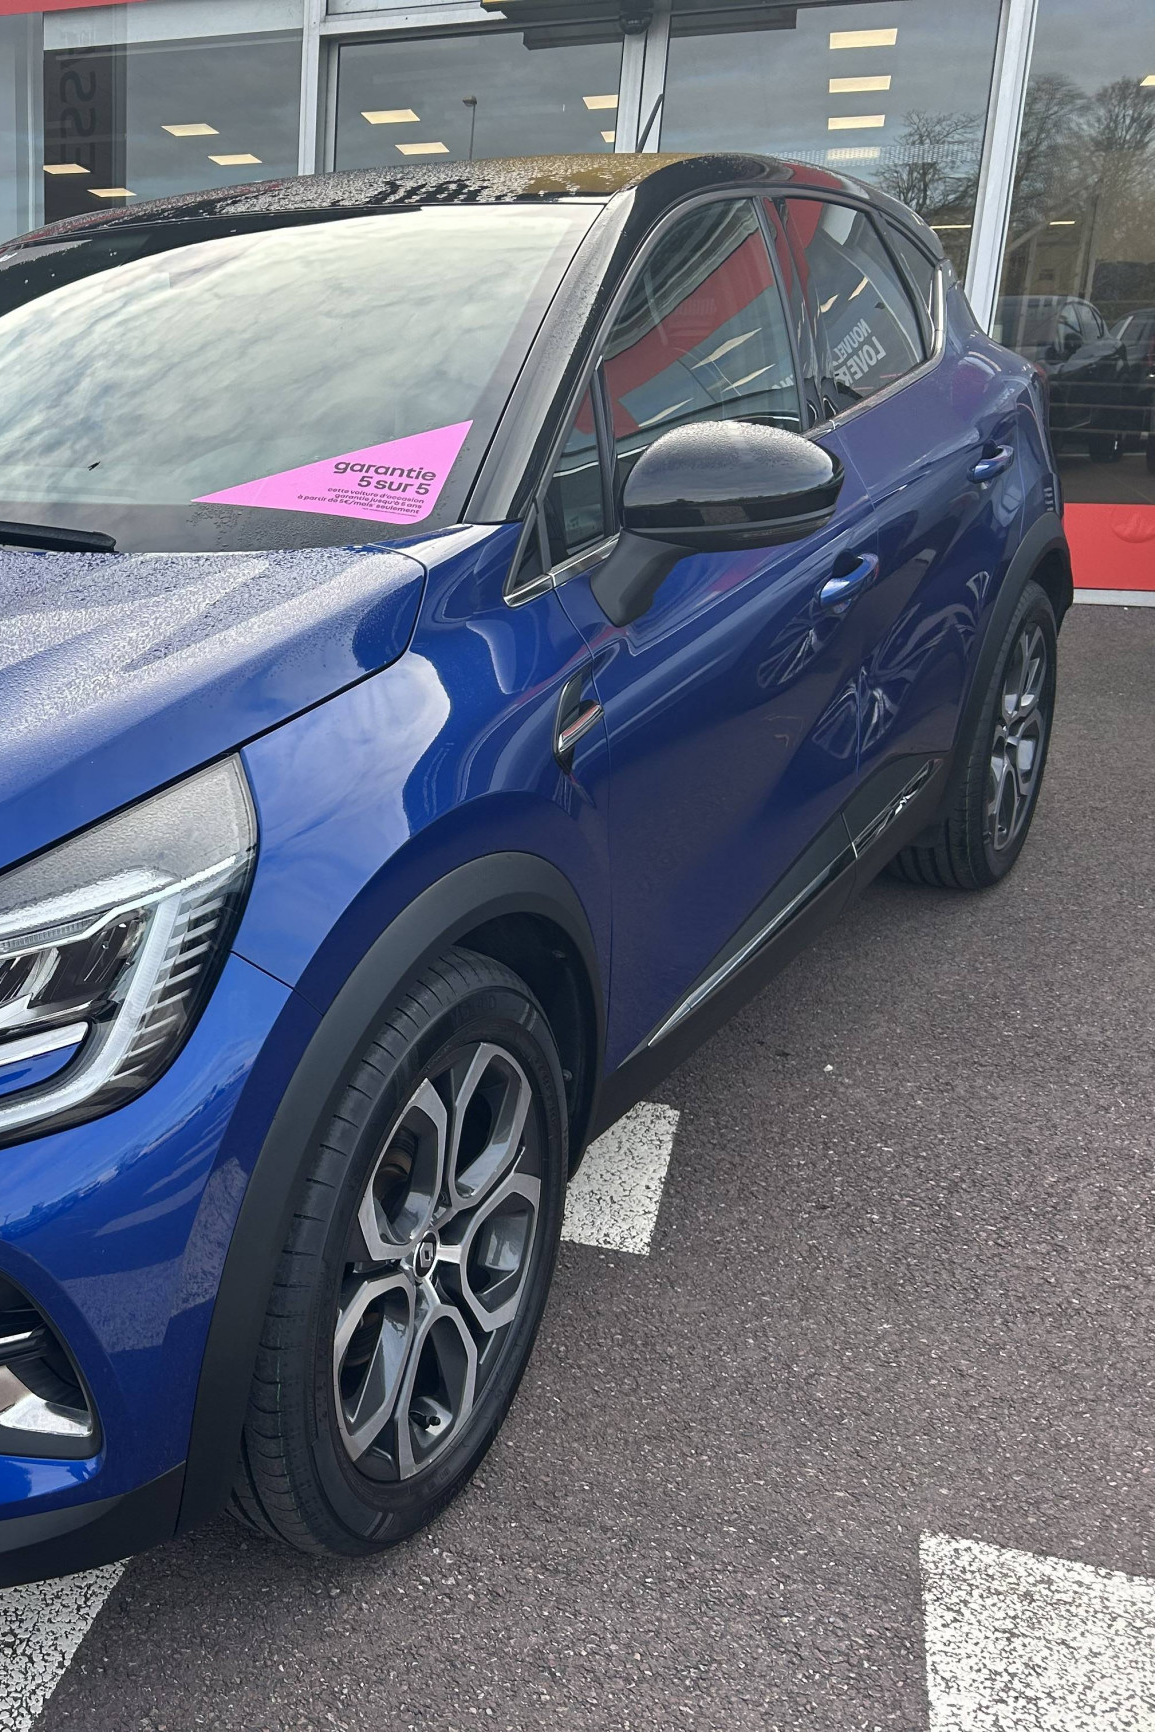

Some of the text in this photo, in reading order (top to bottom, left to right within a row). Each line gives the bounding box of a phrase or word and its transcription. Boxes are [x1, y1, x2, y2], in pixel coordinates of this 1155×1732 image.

[333, 461, 437, 481] garantie
[357, 475, 431, 496] 5 sur 5
[334, 493, 369, 502] garantie
[350, 489, 379, 498] voiture
[379, 493, 425, 504] d'occasion
